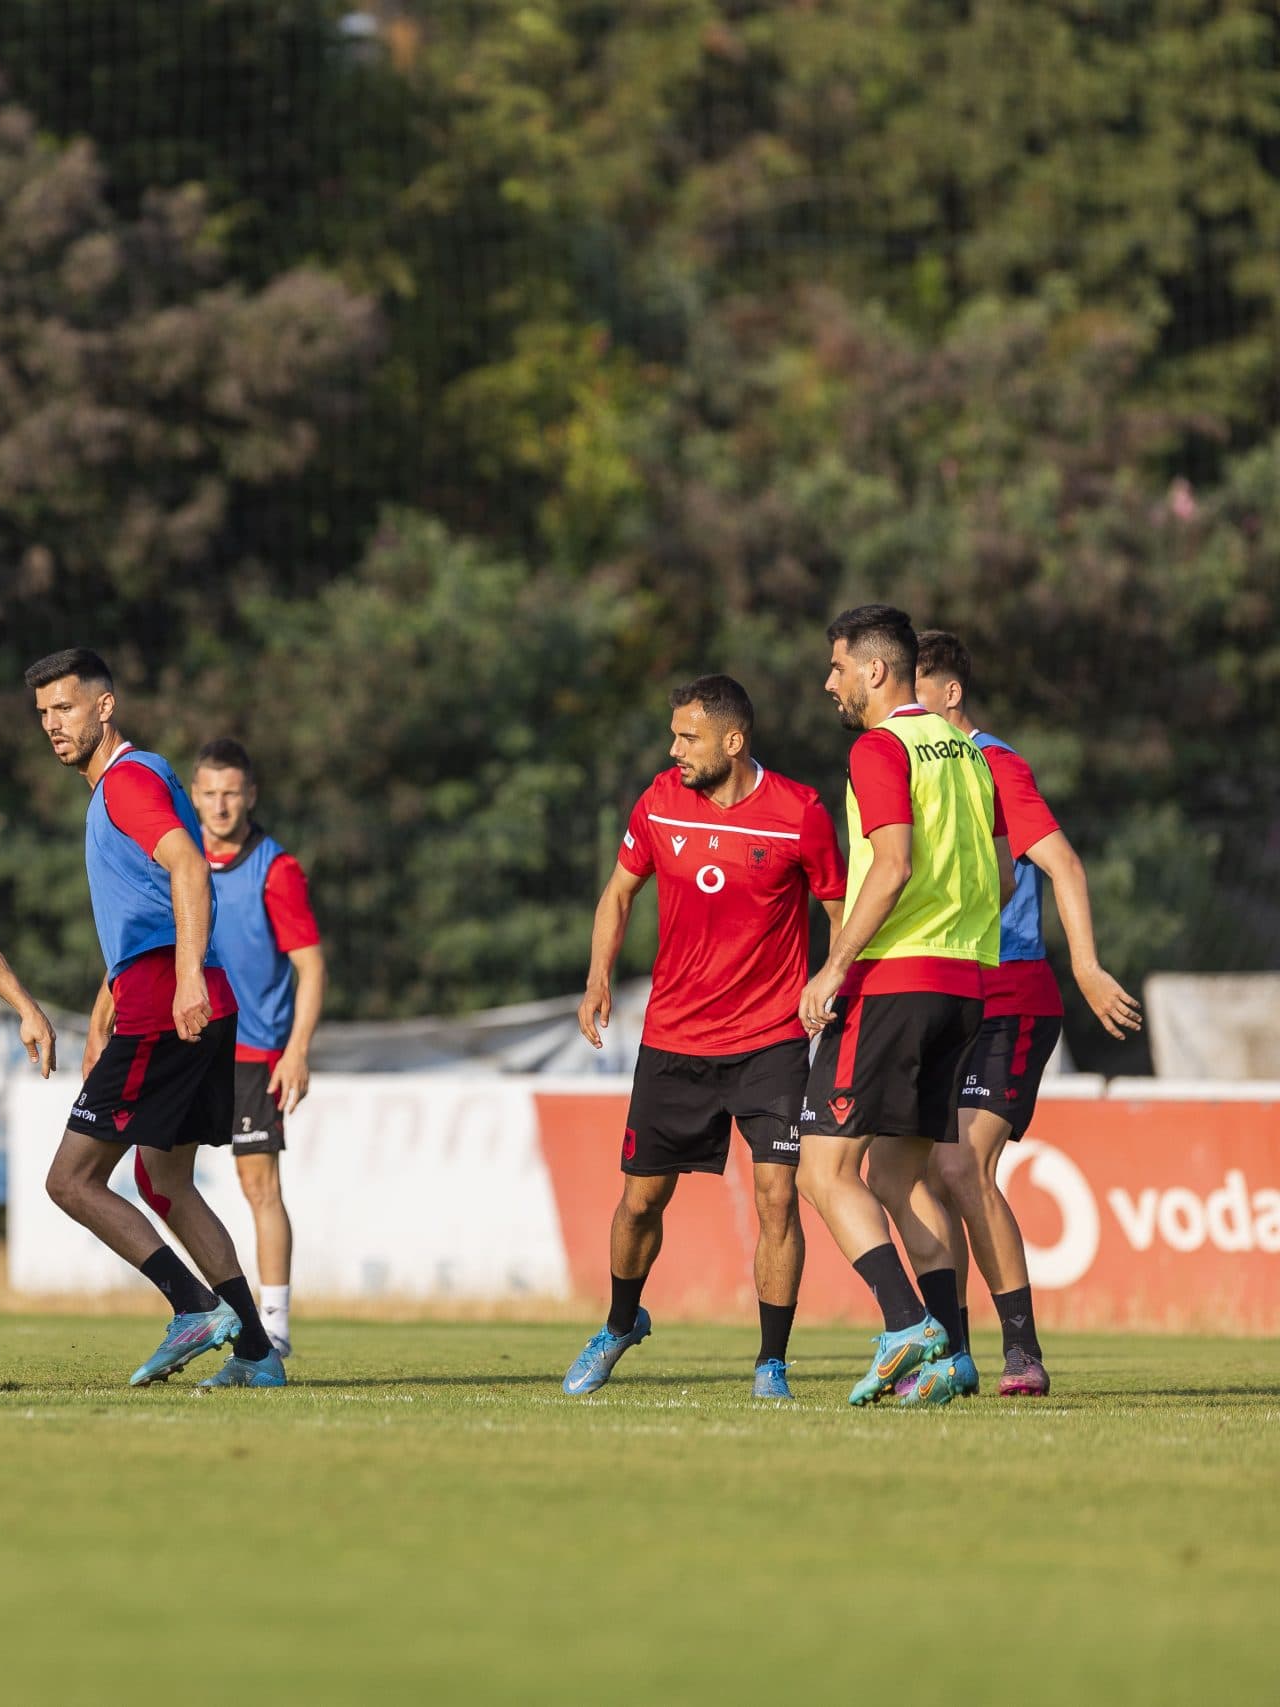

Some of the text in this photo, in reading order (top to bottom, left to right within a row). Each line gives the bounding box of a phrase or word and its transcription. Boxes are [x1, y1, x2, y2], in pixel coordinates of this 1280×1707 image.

[708, 834, 719, 850] 14
[966, 1074, 977, 1086] 15
[78, 1092, 88, 1106] 8
[790, 1125, 799, 1140] 14
[772, 1140, 800, 1151] macr
[1106, 1168, 1280, 1252] voda
